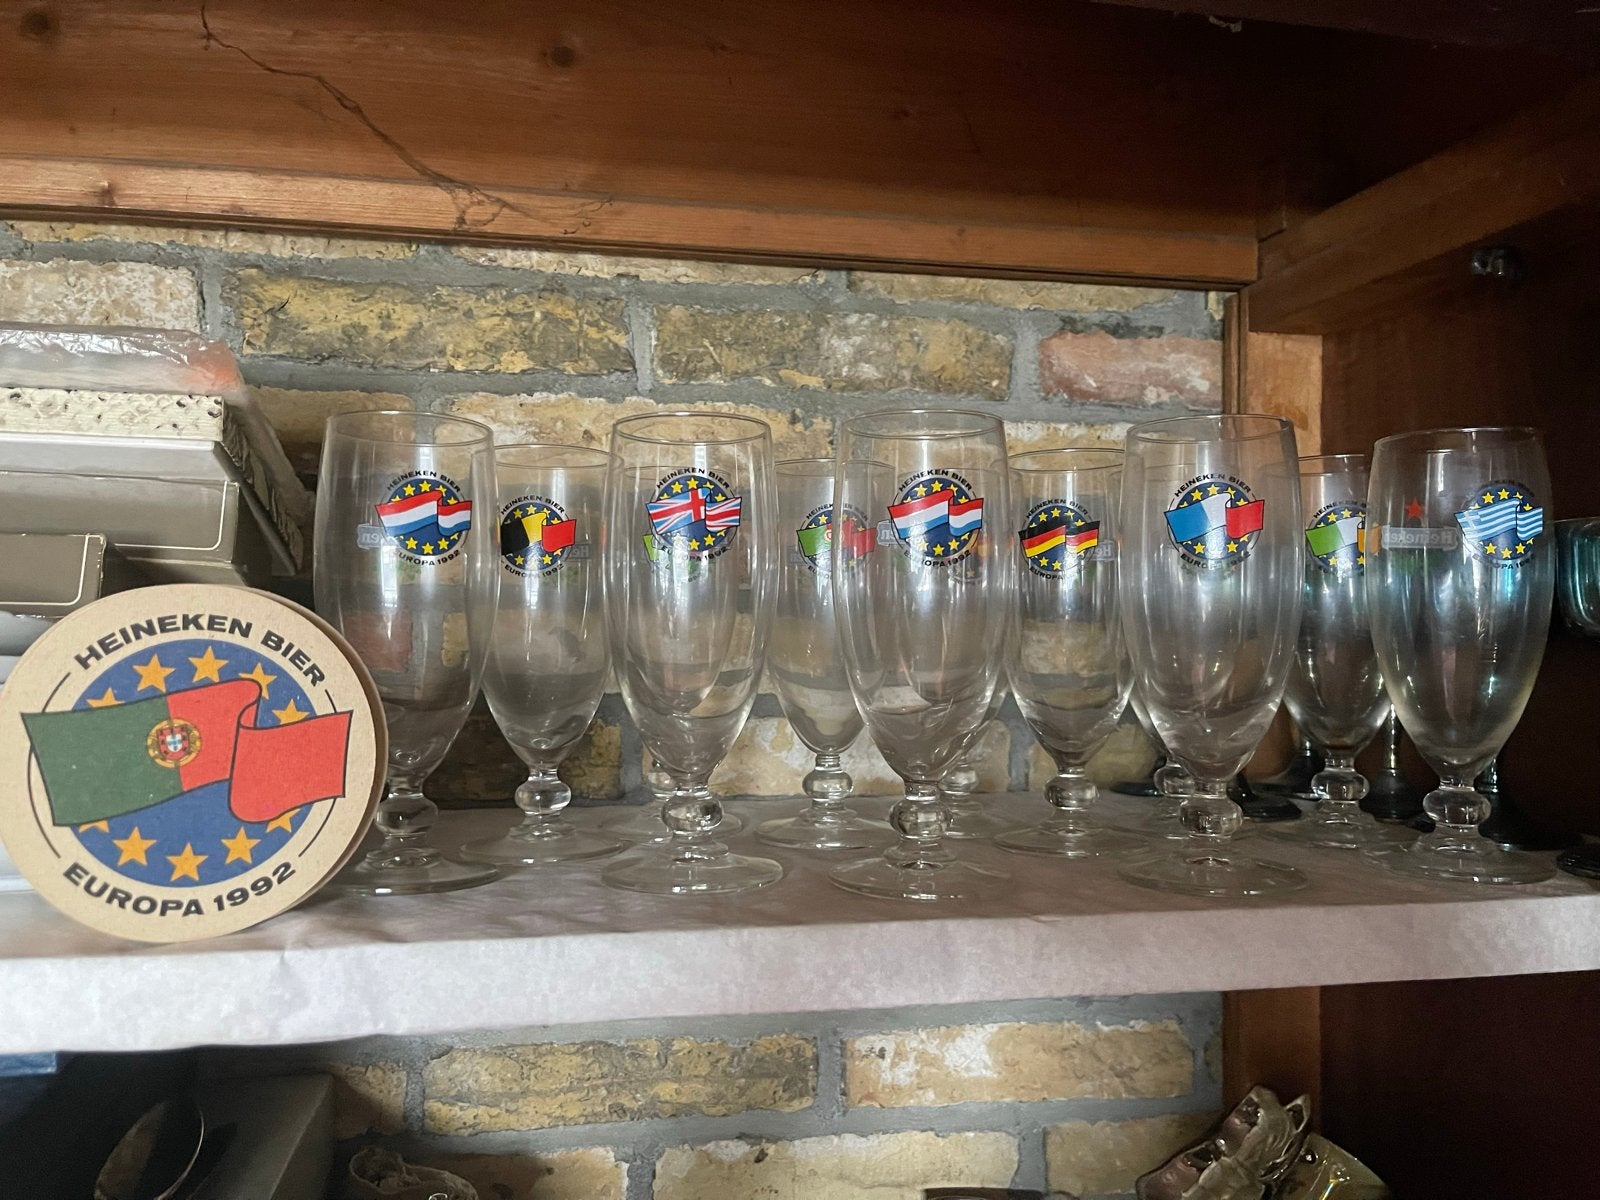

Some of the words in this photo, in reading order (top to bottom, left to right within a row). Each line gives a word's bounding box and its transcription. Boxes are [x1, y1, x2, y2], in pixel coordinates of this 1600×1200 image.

[386, 470, 437, 491] HEINEKEN
[440, 474, 461, 492] BIER
[655, 467, 705, 489] HEINEKEN
[708, 471, 730, 489] BIER
[899, 469, 949, 492] HEINEKEN
[951, 472, 972, 491] BIER
[1174, 473, 1226, 497] HEINEKEN
[1228, 476, 1251, 493] BIER
[500, 494, 542, 515] HEINEKEN
[545, 498, 565, 514] BIER
[1026, 498, 1067, 519] HEINEKEN
[1069, 501, 1088, 515] BIER
[437, 549, 460, 565] 1992
[661, 545, 702, 562] EUPA
[904, 551, 946, 567] EOPA
[1180, 553, 1220, 569] EURO
[504, 564, 540, 578] EURO
[74, 614, 253, 670] HEINEKEN
[261, 630, 326, 687] BIER
[63, 862, 204, 917] EUROPA
[213, 861, 296, 910] 1992
